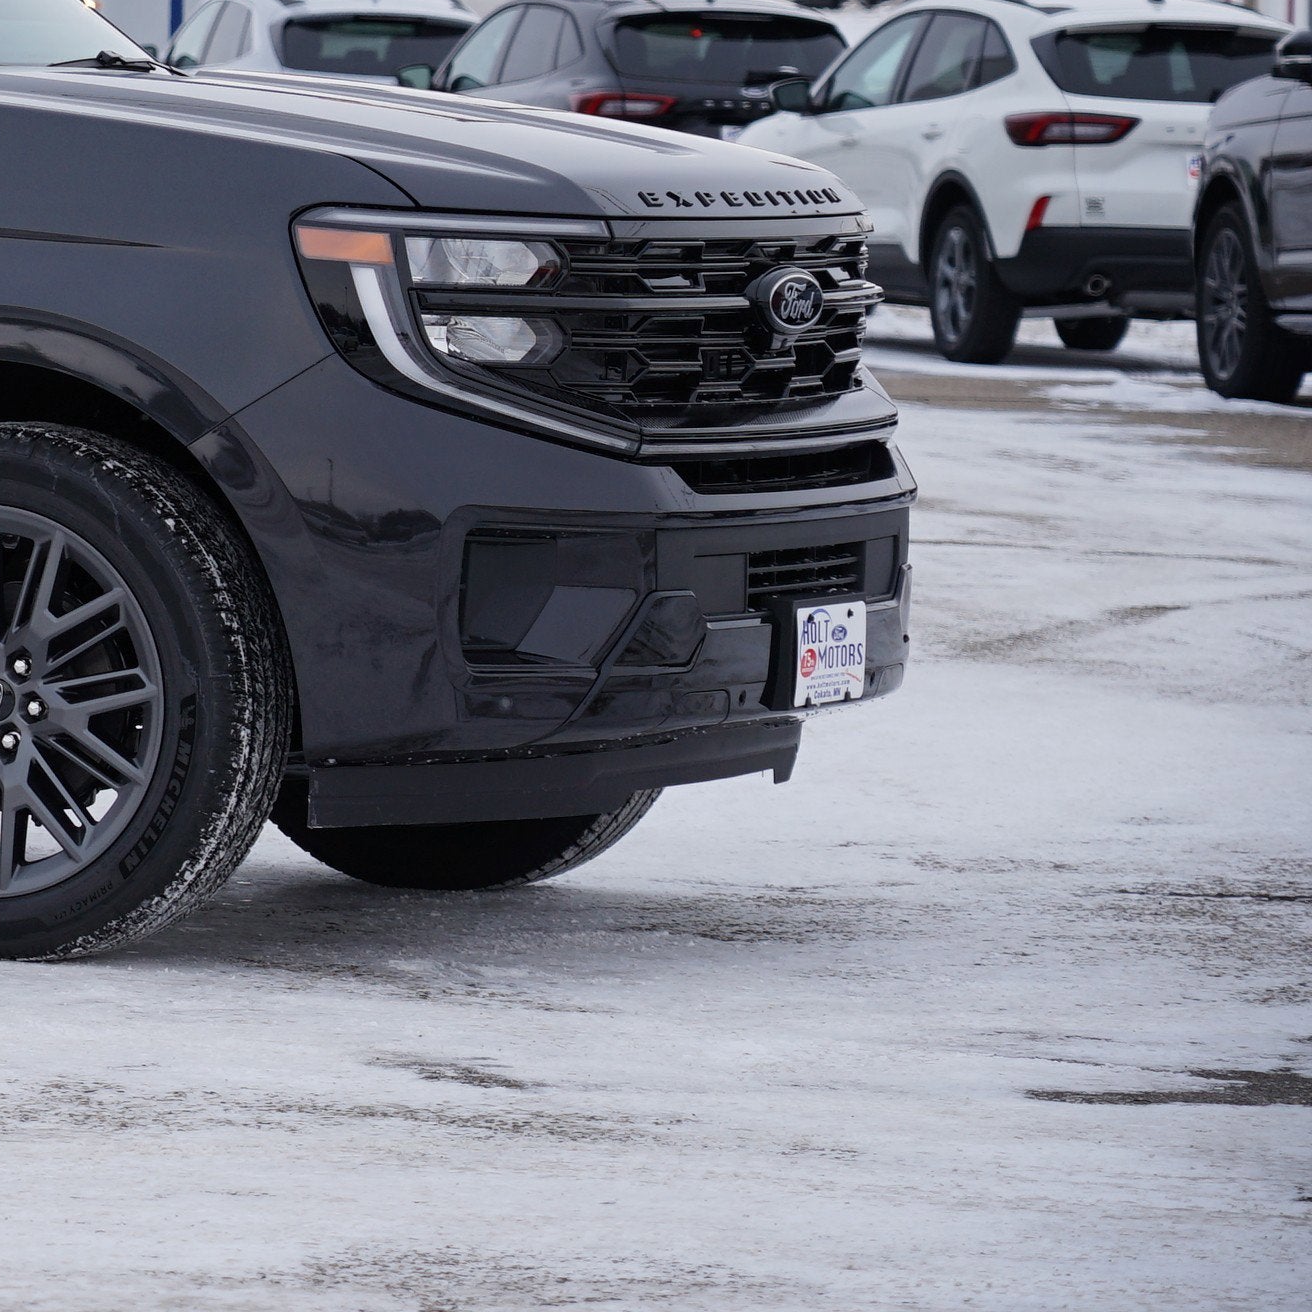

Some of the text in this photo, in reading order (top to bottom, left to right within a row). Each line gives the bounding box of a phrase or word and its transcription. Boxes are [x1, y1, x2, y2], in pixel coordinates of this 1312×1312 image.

[638, 188, 842, 208] EXPEDITION
[780, 282, 815, 320] Ford
[803, 619, 830, 645] HOLT
[818, 643, 863, 670] MOTORS
[126, 740, 192, 874] MICHELIN
